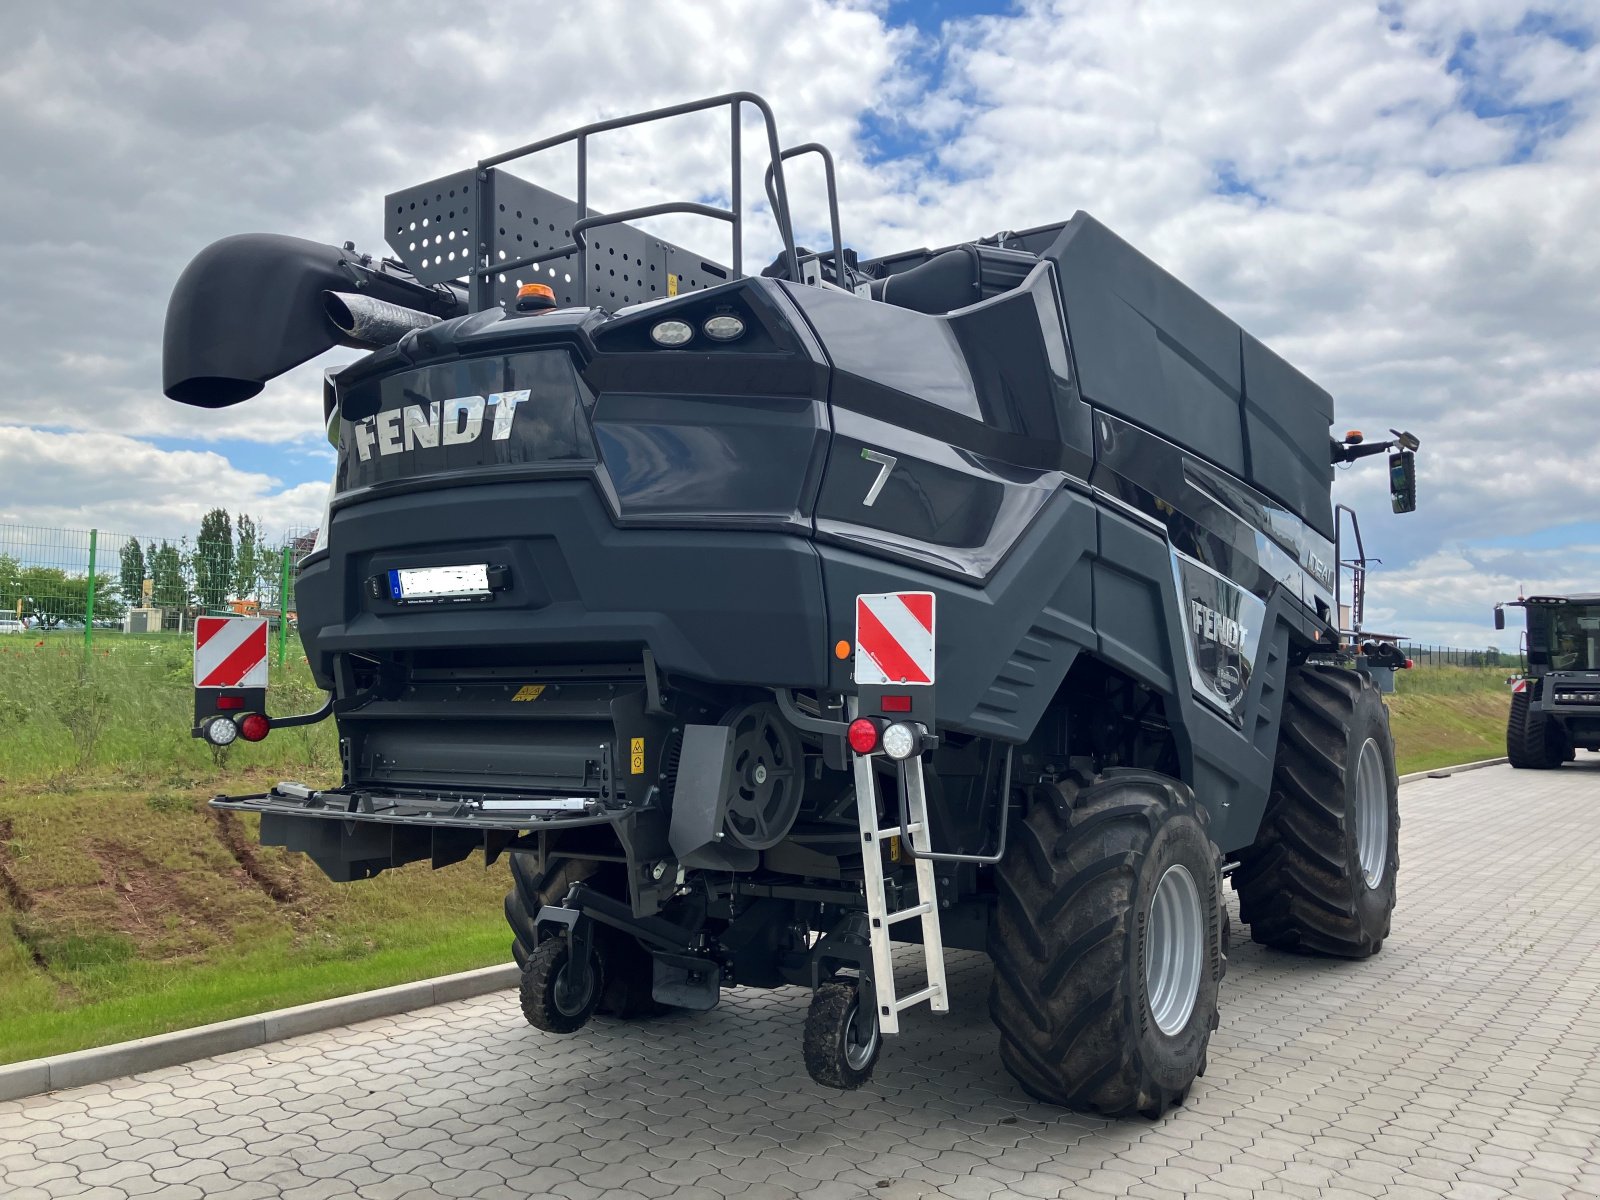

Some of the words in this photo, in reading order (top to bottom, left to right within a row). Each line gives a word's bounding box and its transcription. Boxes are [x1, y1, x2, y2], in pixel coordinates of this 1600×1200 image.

[353, 389, 532, 462] FENDT
[860, 447, 898, 507] 7
[1191, 600, 1249, 653] FENDT
